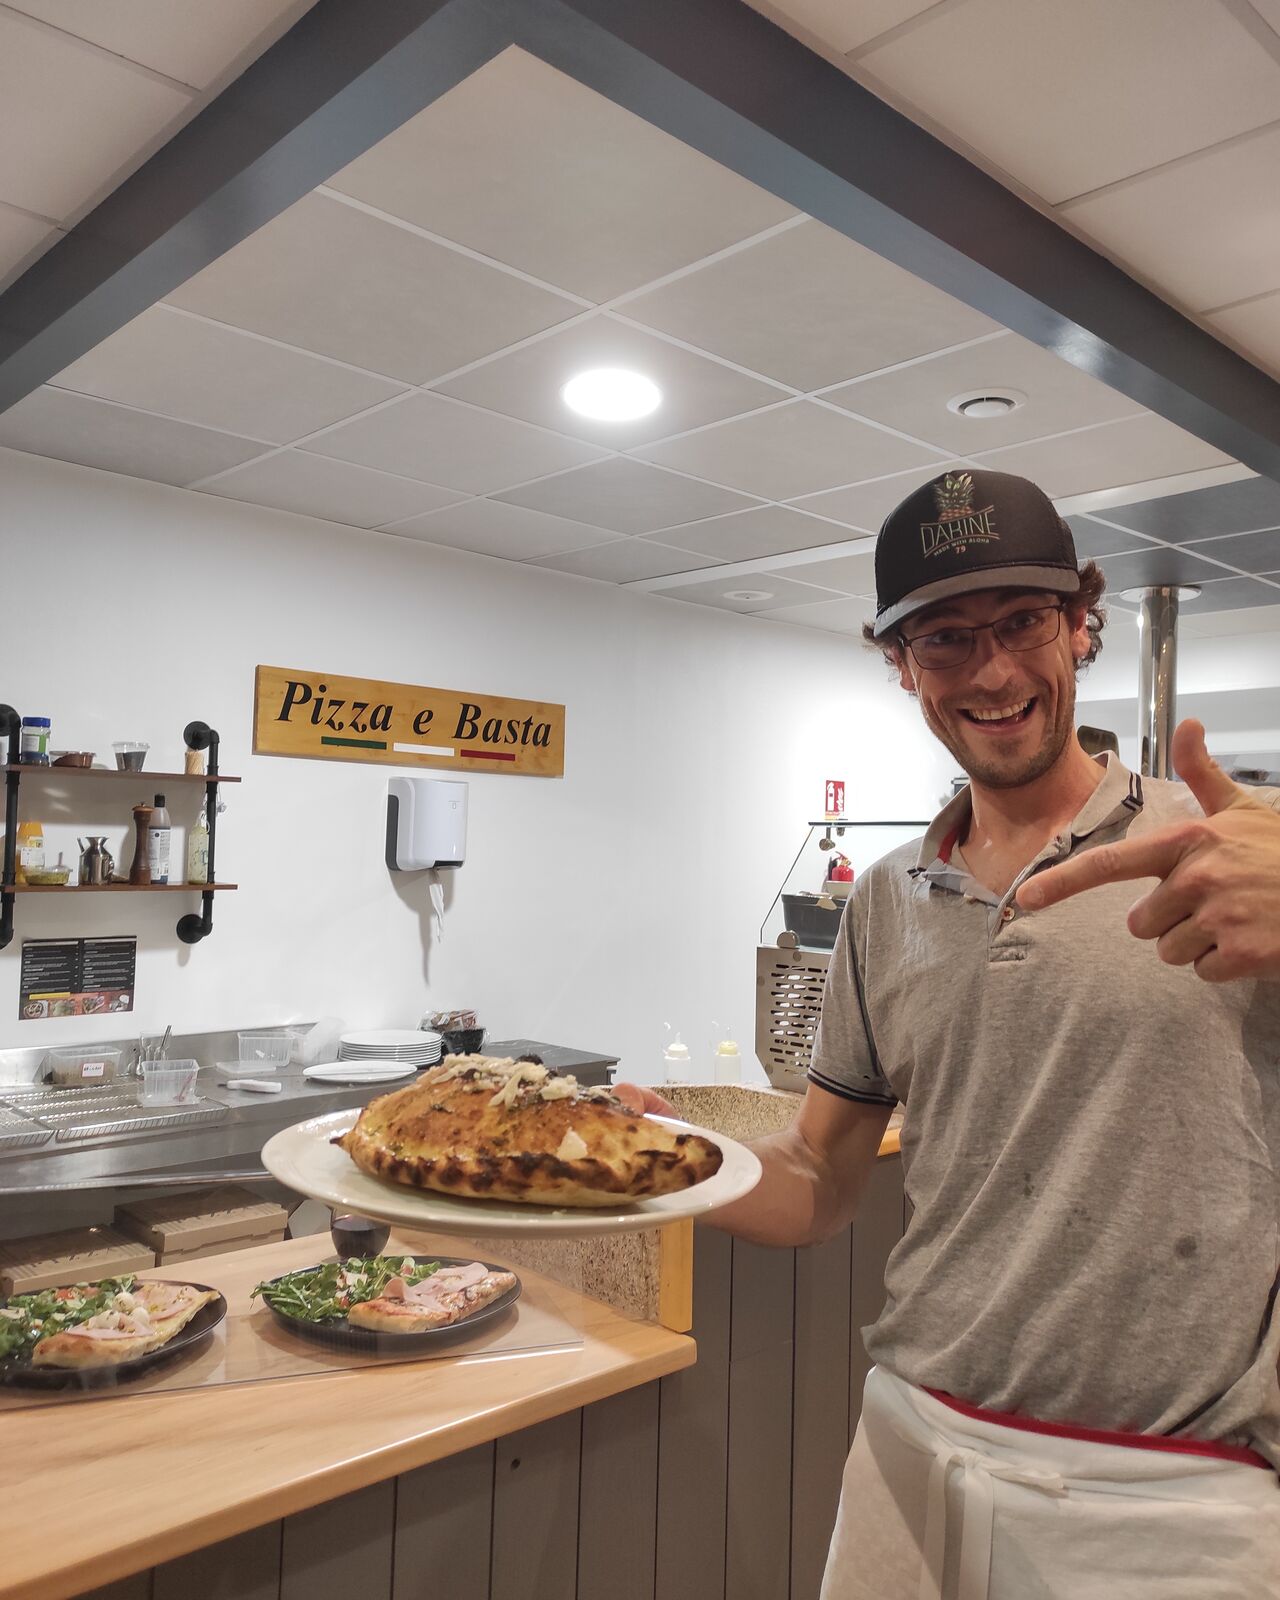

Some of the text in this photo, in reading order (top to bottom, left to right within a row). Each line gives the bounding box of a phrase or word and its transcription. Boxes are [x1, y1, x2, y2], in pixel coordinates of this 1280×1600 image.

[955, 545, 966, 554] 79
[274, 680, 552, 747] Pizza e Basta
